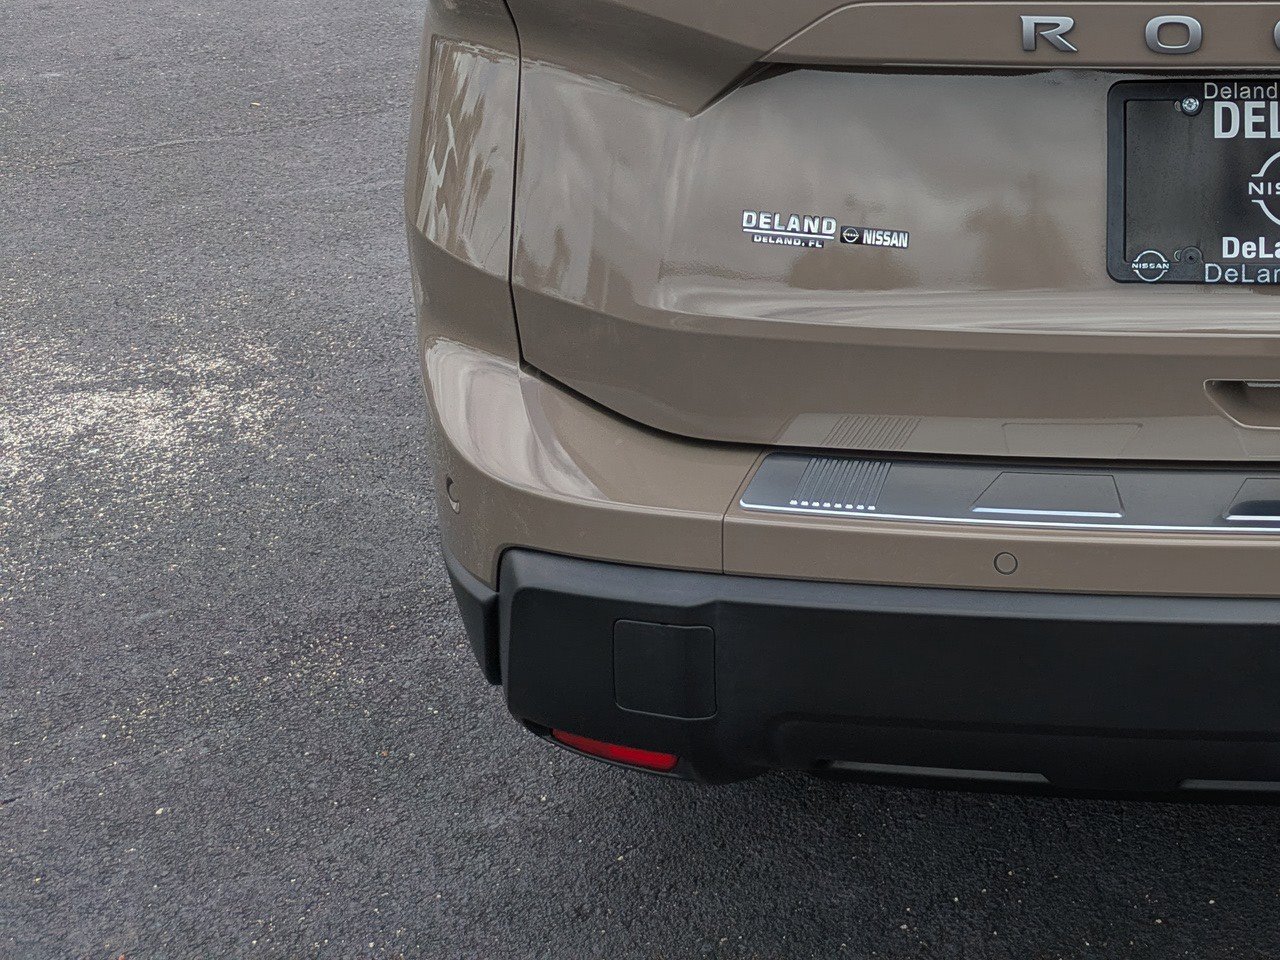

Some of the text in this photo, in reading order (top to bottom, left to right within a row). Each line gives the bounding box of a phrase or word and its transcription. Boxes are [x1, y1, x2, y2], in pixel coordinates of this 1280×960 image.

[742, 210, 908, 248] DELAND NISSAN
[1131, 261, 1170, 270] NISSAN
